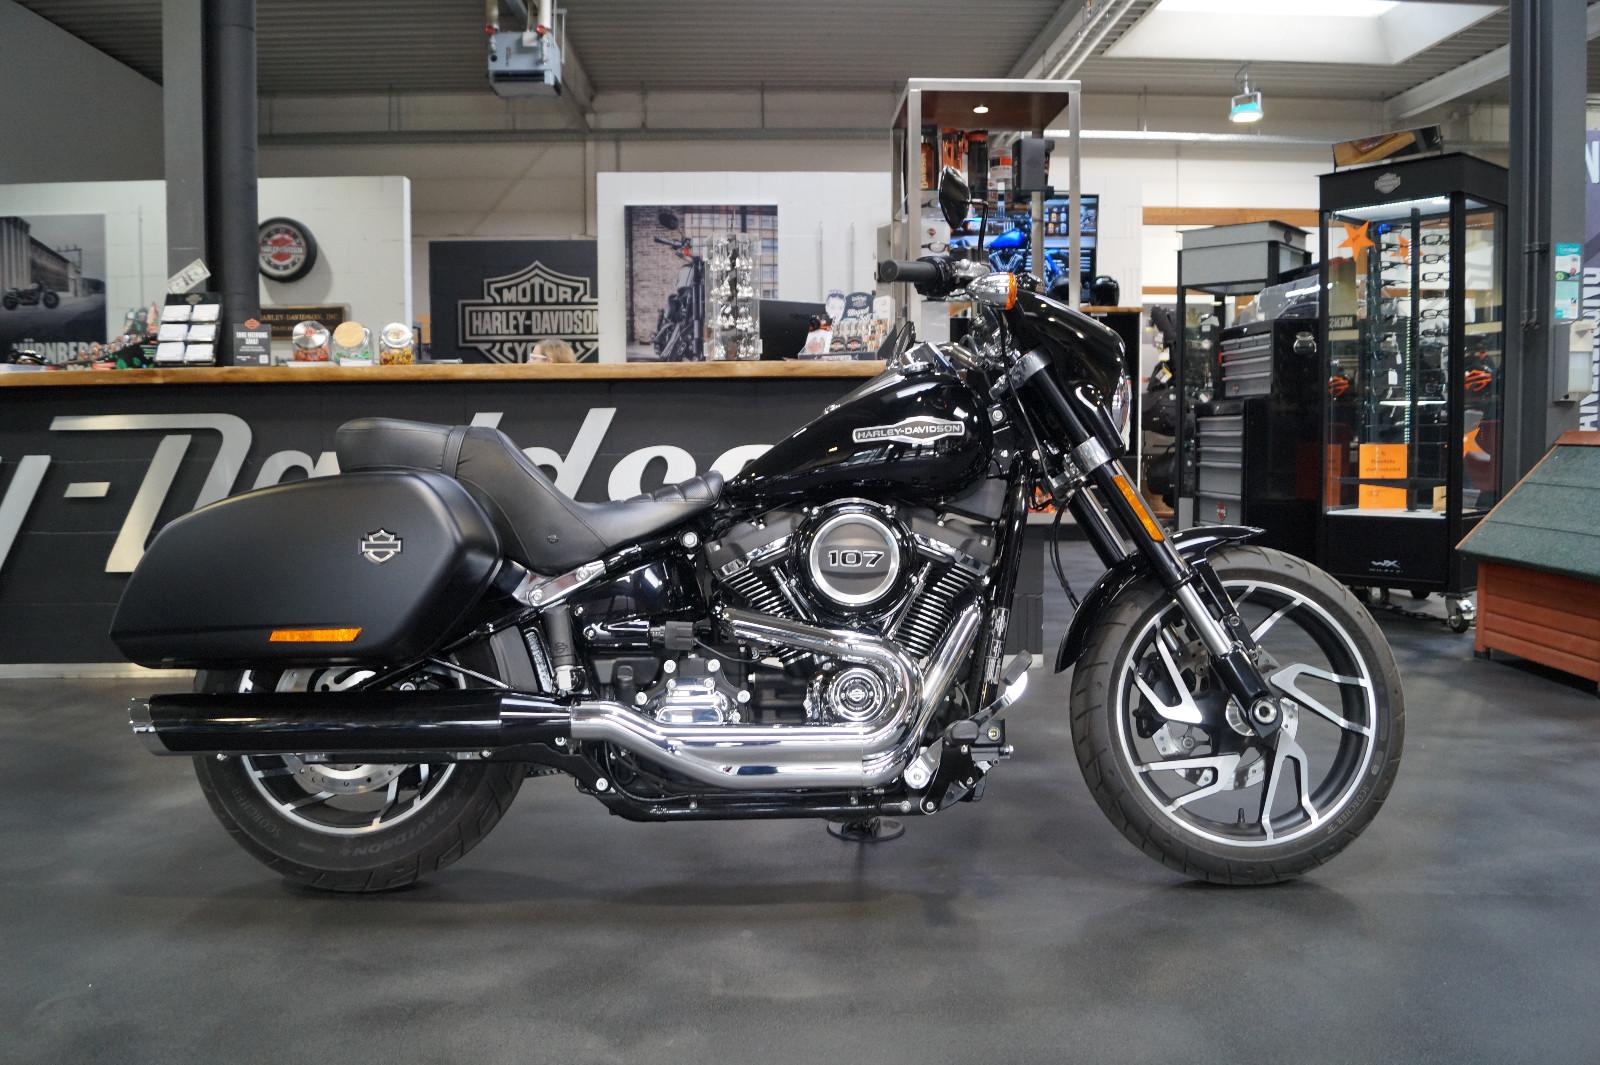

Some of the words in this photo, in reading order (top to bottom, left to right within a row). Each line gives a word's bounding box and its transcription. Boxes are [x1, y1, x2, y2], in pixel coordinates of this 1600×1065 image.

[502, 275, 572, 303] MOTOR
[472, 310, 598, 334] HARLEY-DAVIDSON
[857, 424, 961, 439] HARLEY-DAVIDSON
[828, 549, 884, 568] 107
